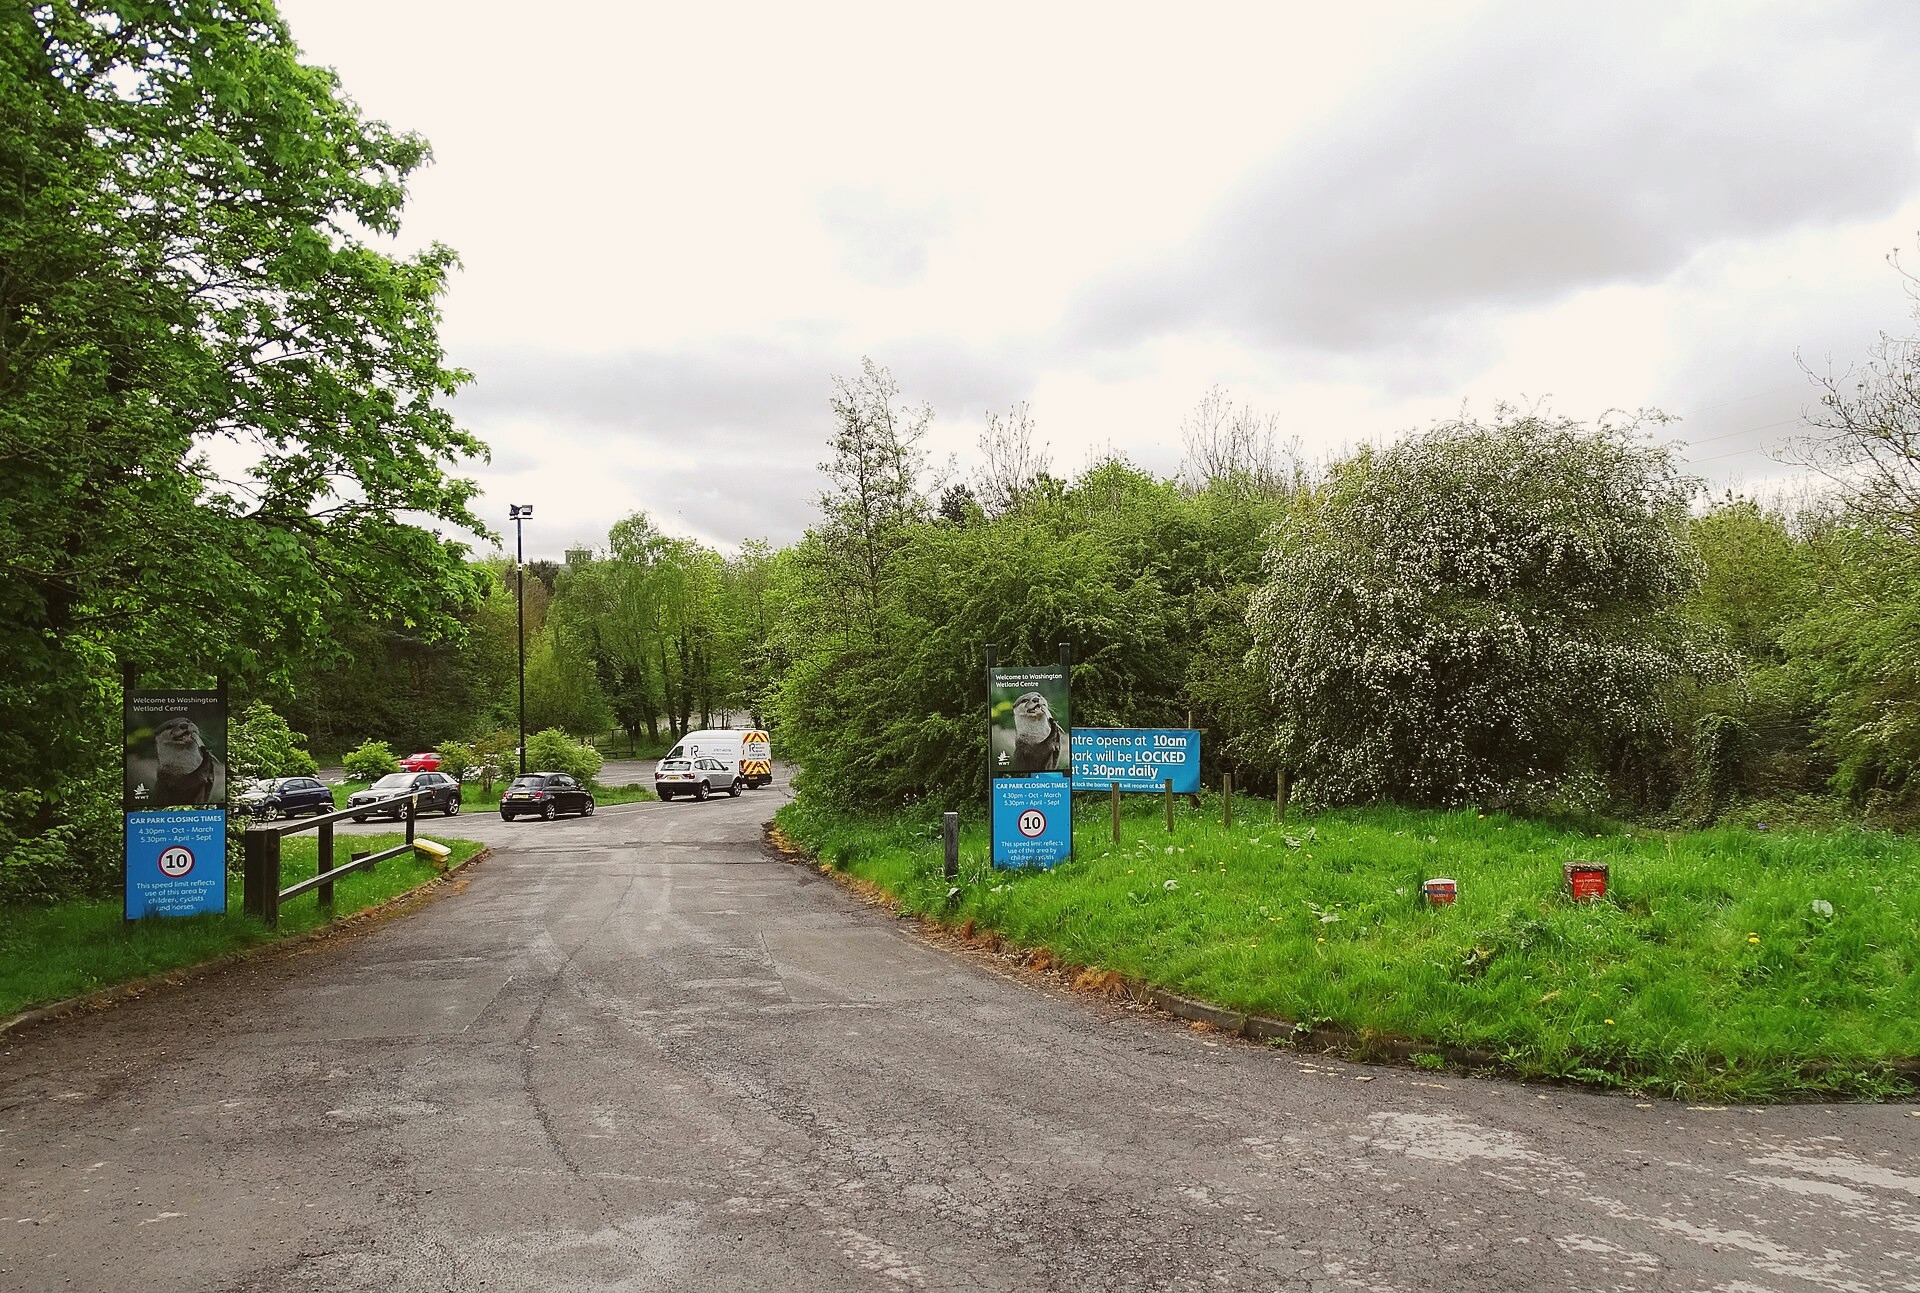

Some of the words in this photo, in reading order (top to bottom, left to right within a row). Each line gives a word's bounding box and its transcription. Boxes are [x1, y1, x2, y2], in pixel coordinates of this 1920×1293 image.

[1072, 736, 1093, 746] ntre
[1096, 737, 1131, 748] opens
[1134, 737, 1147, 746] at
[1153, 735, 1187, 746] 10am
[1096, 750, 1114, 762] will
[1117, 751, 1132, 762] be
[1135, 751, 1186, 762] LOCKED
[1082, 764, 1125, 778] 5.30pm
[1128, 765, 1158, 779] daily
[1024, 817, 1040, 829] 10
[166, 854, 188, 868] 10
